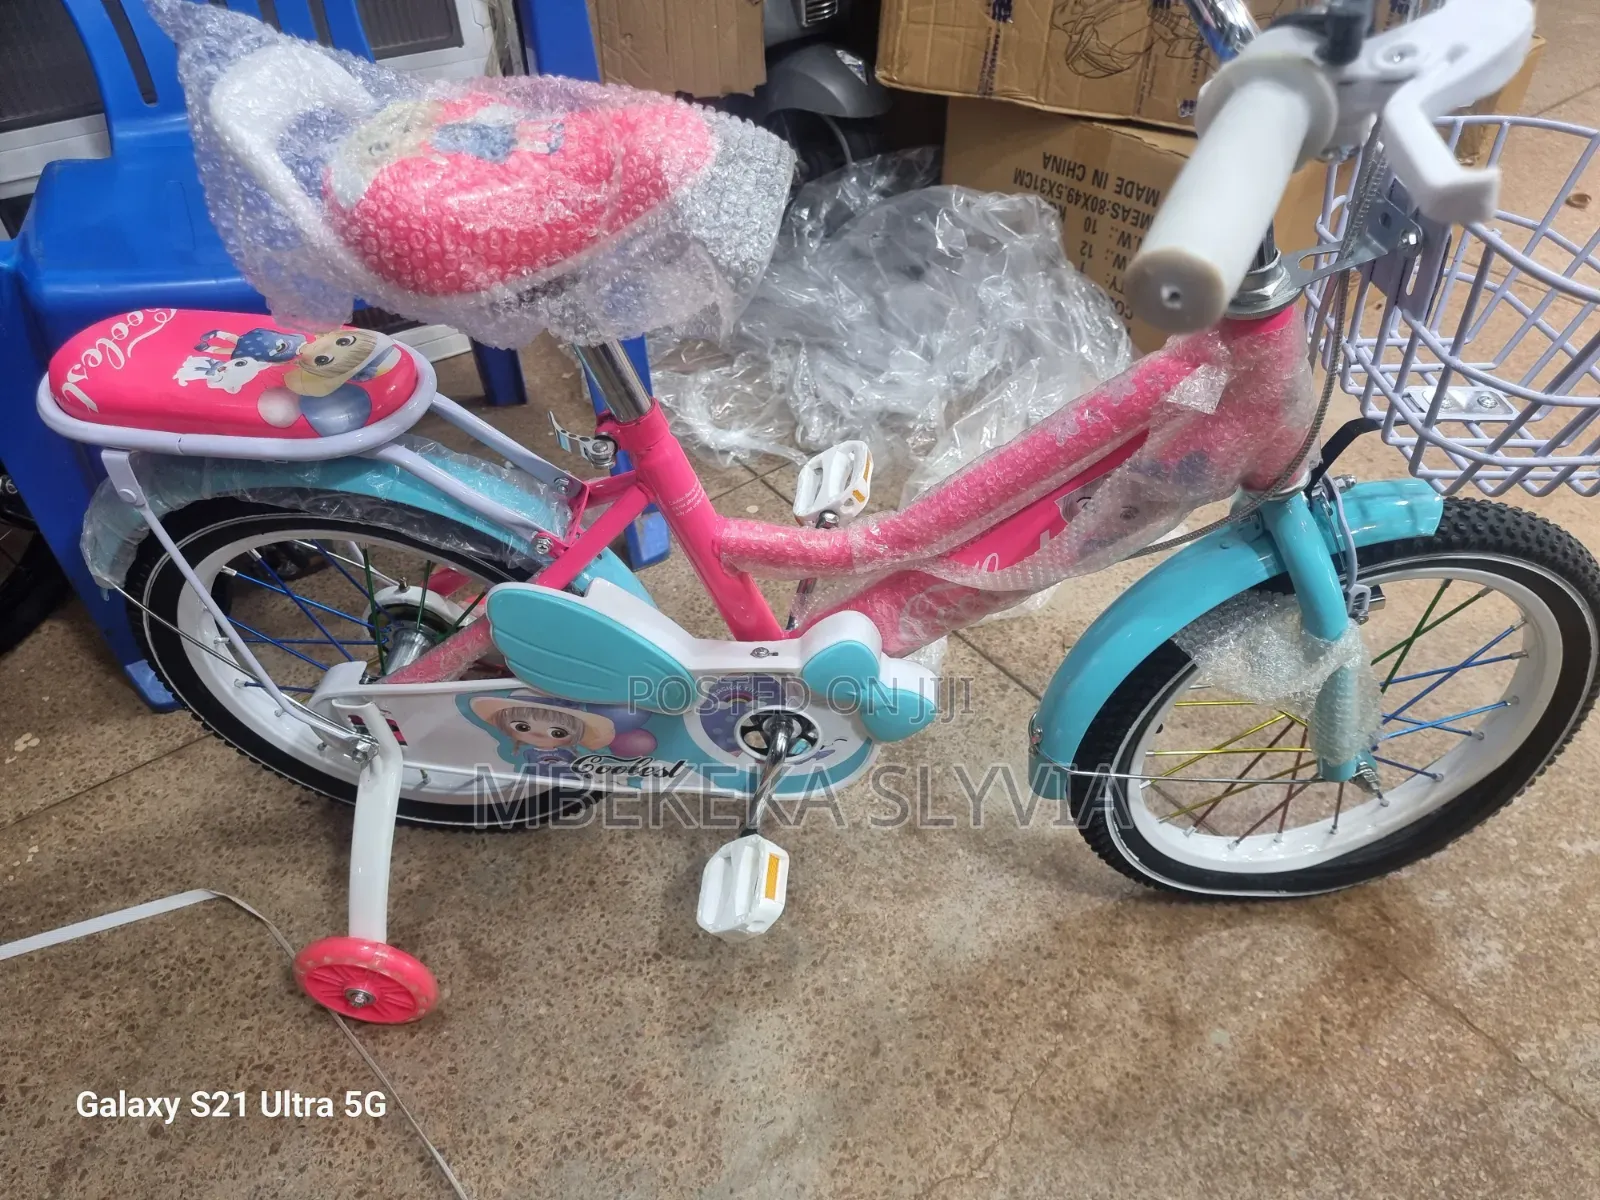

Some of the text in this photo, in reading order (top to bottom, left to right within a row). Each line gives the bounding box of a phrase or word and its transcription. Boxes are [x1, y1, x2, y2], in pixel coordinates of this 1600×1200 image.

[1042, 152, 1160, 206] MADE IN CHINA
[1084, 216, 1097, 235] 10
[1080, 240, 1093, 258] 12
[570, 755, 687, 779] Coolest
